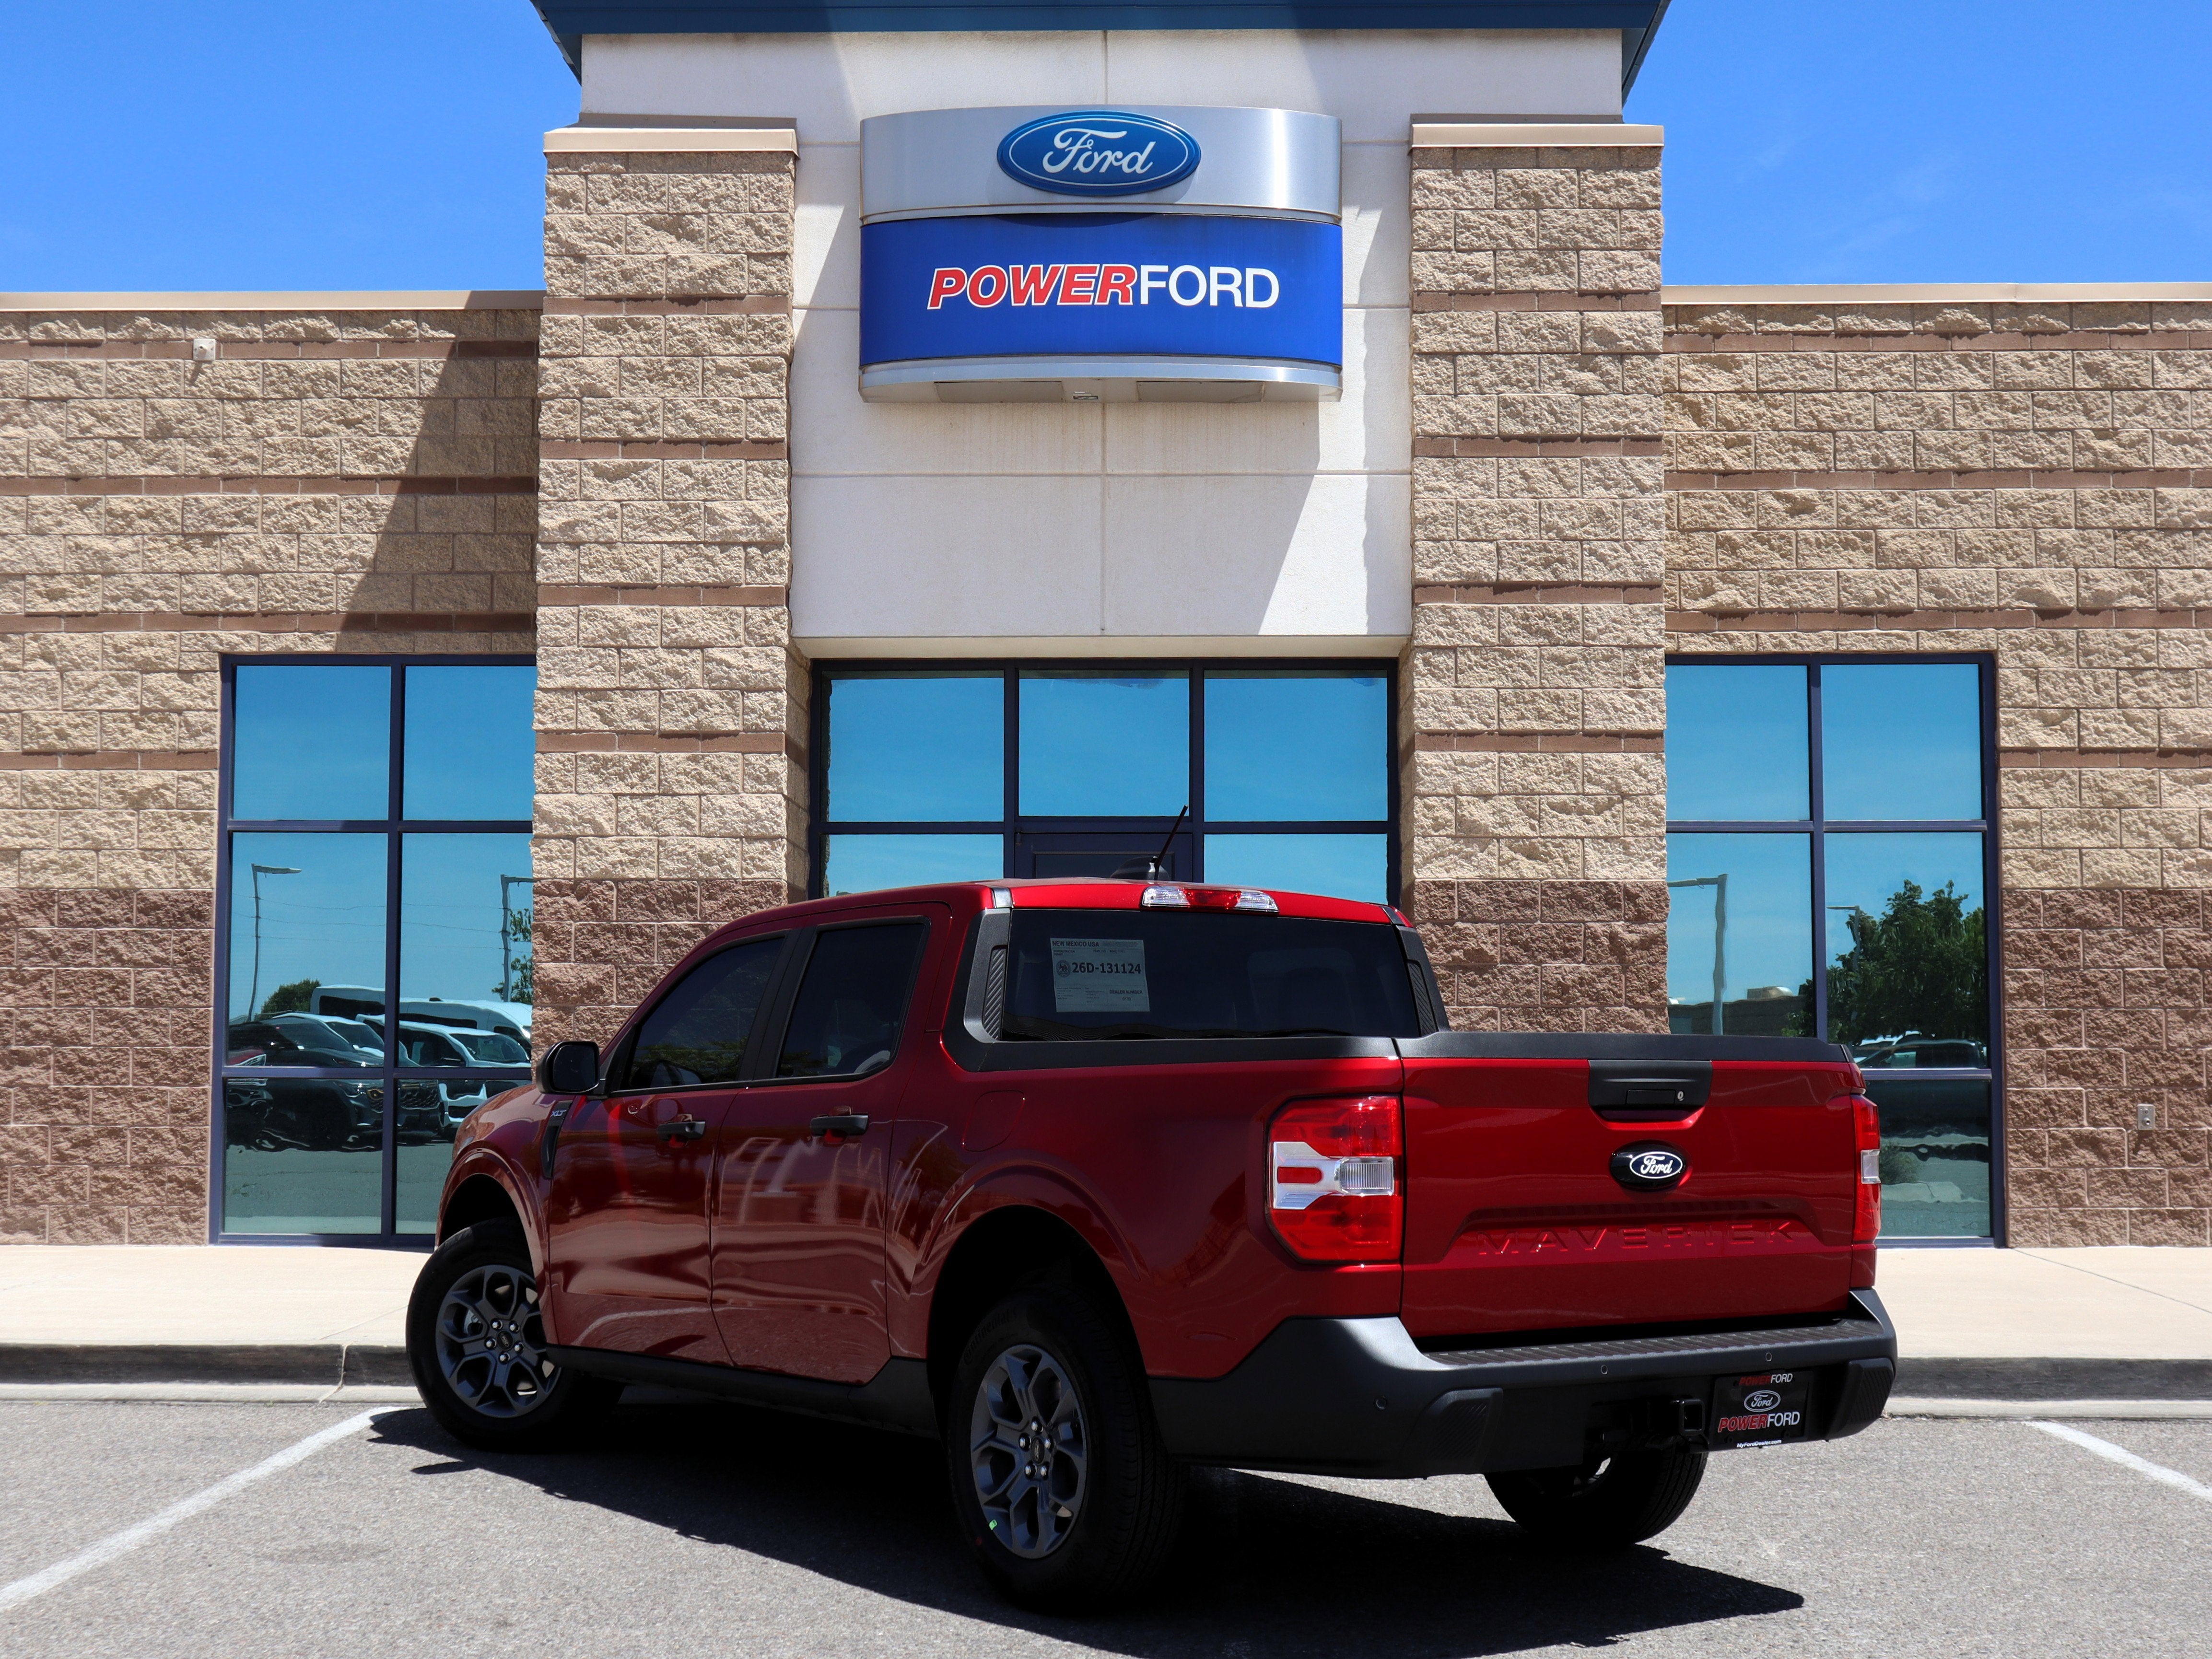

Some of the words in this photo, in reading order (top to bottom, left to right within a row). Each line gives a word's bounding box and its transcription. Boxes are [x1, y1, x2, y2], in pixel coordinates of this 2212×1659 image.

[1042, 128, 1157, 175] Ford
[926, 263, 1280, 310] POWERFORD
[1072, 962, 1142, 974] 26D-131124
[1640, 1155, 1674, 1174] Ford
[1476, 1221, 1796, 1255] MAVERICK
[1739, 1373, 1793, 1386] POWERFORD
[1751, 1394, 1773, 1407] Ford
[1718, 1411, 1801, 1433] POWERFORD
